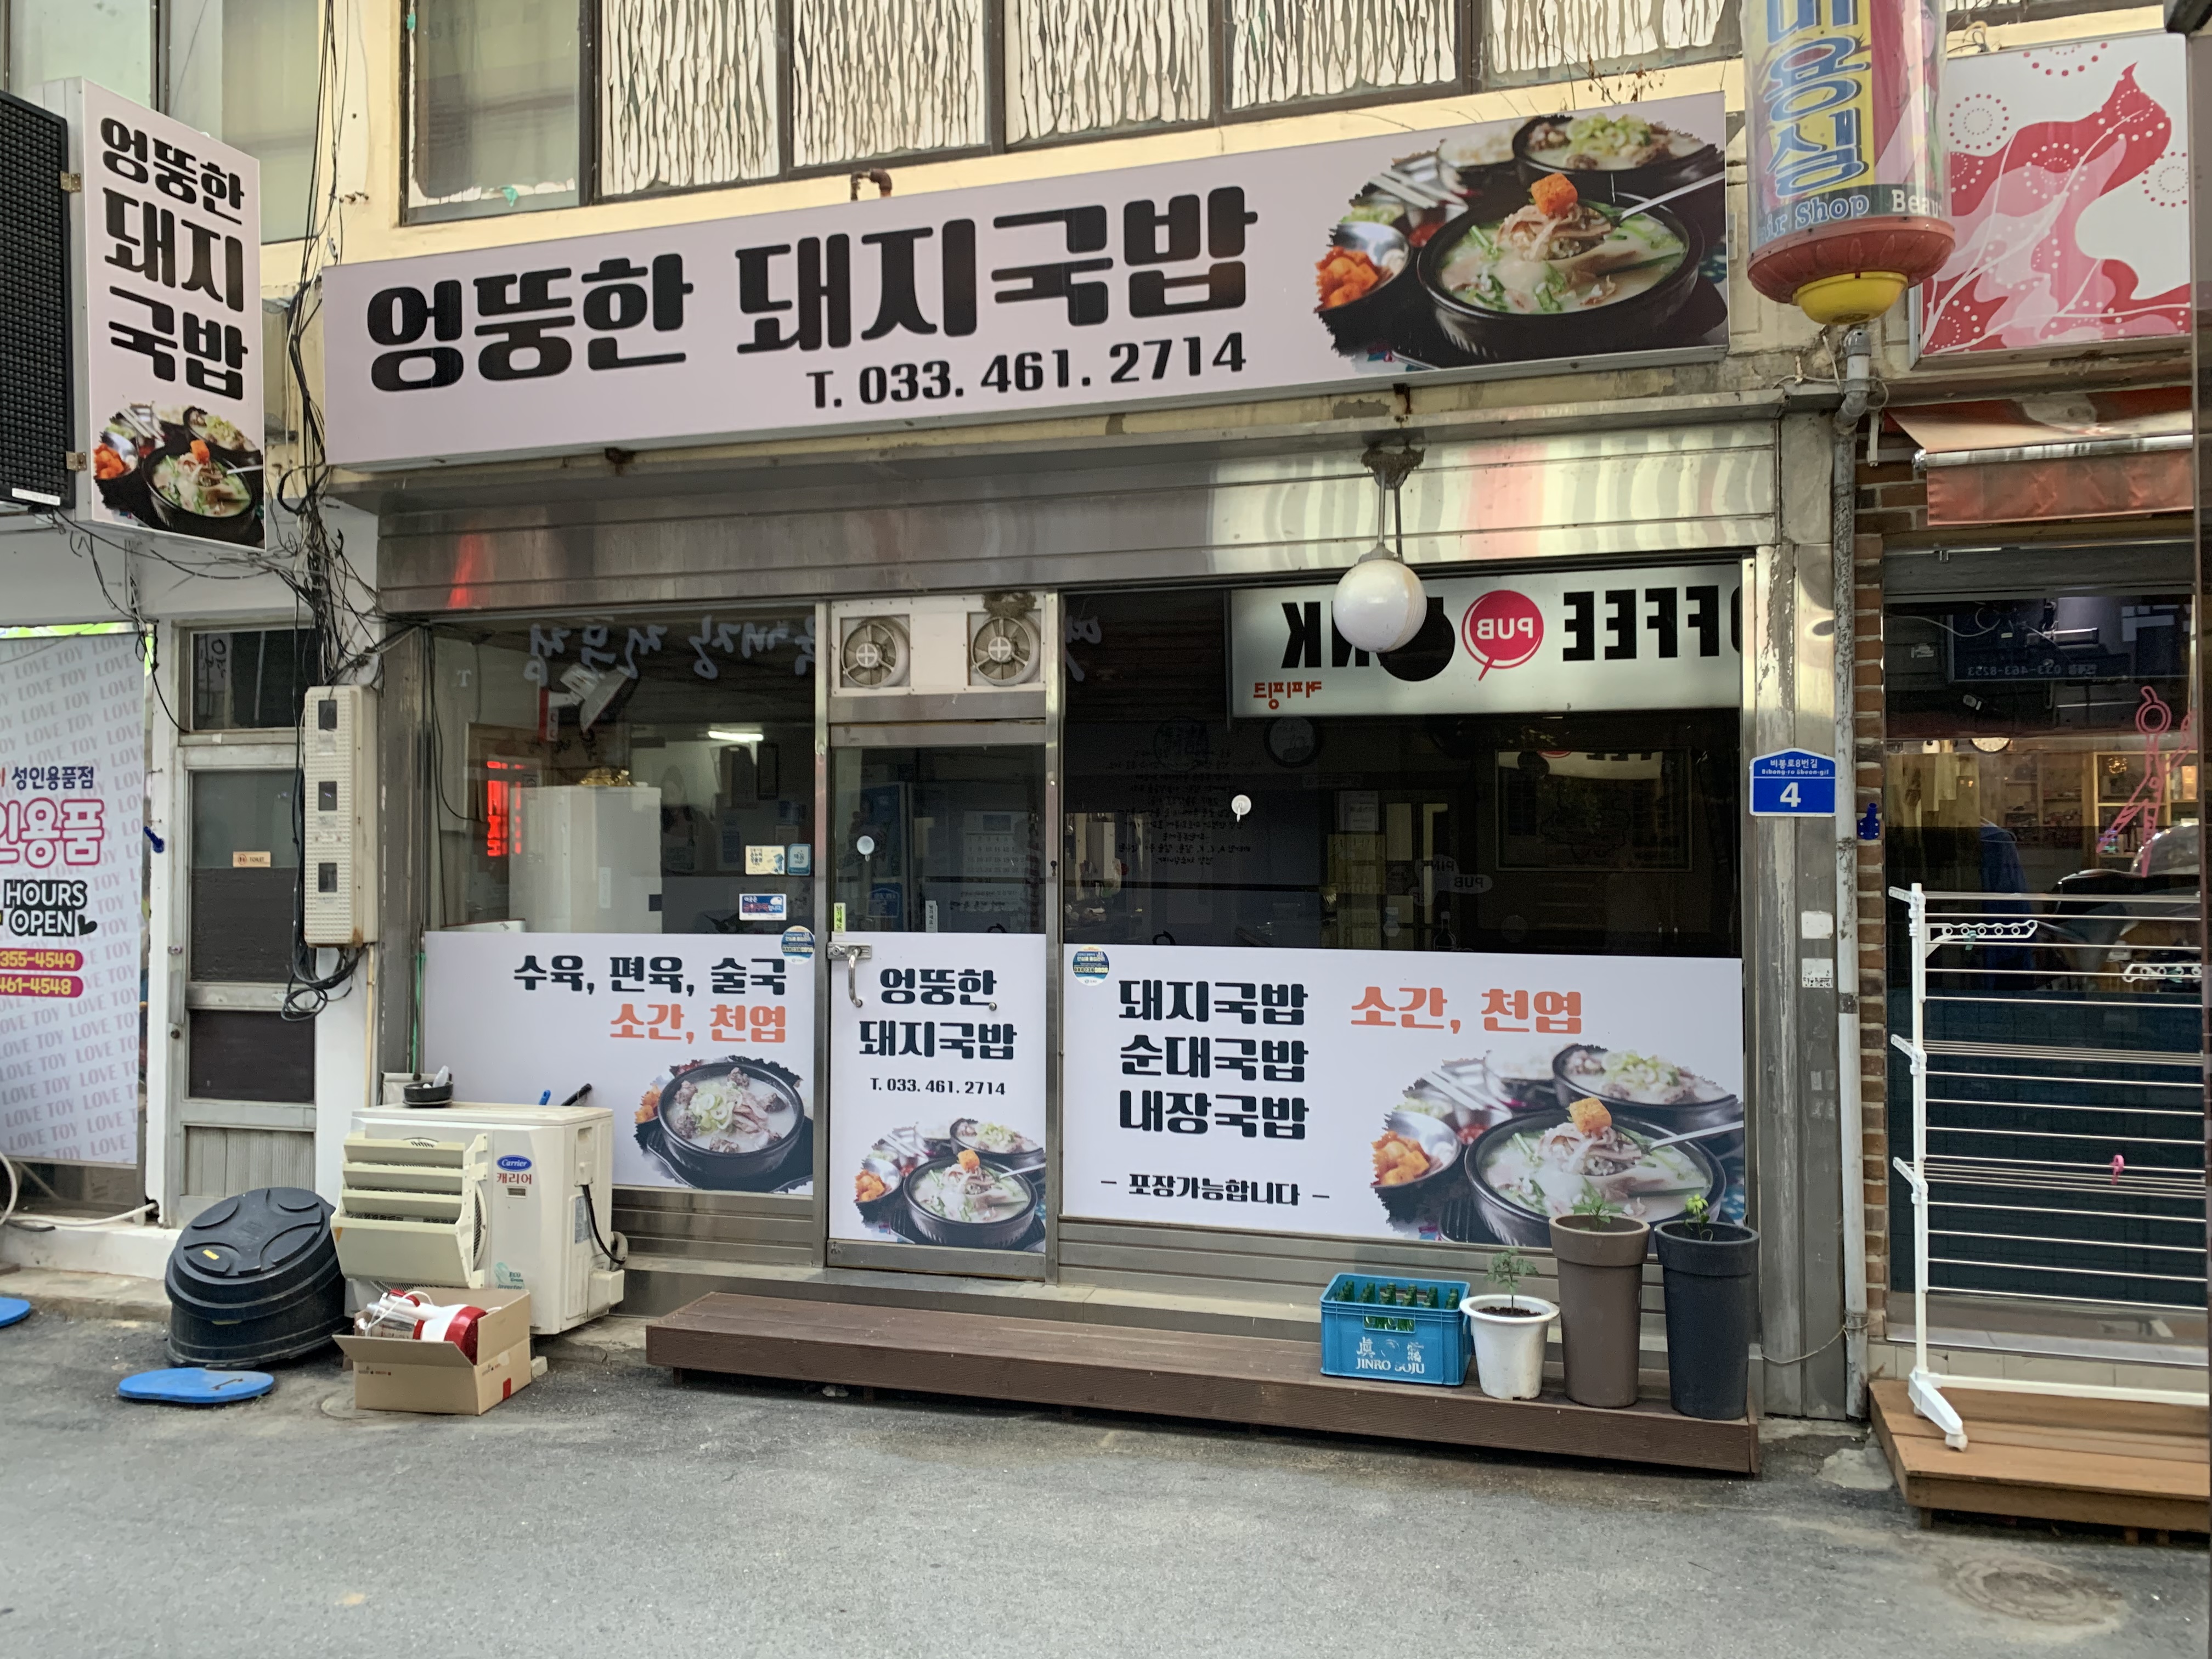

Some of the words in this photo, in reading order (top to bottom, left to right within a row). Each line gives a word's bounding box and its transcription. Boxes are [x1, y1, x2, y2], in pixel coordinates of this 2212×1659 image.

[100, 117, 245, 225] 엉뚱한
[1795, 194, 1870, 229] Shop
[103, 187, 244, 313] 돼지
[367, 252, 694, 392] 엉뚱한
[735, 185, 1258, 353] 돼지국밥
[108, 285, 249, 400] 국밥
[806, 370, 843, 408] T.
[859, 360, 964, 405] 033.
[981, 349, 1091, 393] 461.
[1109, 332, 1246, 384] 2714
[12, 766, 94, 791] 성인용품점
[1770, 759, 1818, 769] 비봉로8번길
[1780, 782, 1802, 808] 4
[5, 882, 86, 907] HOURS
[11, 909, 74, 934] OPEN
[514, 955, 595, 995] 수육,
[609, 956, 695, 997] 편육,
[710, 957, 787, 996] 술국
[879, 968, 997, 1006] 엉뚱한
[610, 1003, 695, 1044] 소간,
[709, 1004, 786, 1043] 천엽
[1119, 979, 1308, 1025] 돼지국밥
[1351, 986, 1461, 1035] 소간,
[1481, 988, 1582, 1035] 천엽
[859, 1020, 1017, 1060] 돼지국밥
[1120, 1035, 1309, 1082] 순대국밥
[870, 1077, 882, 1091] T.
[887, 1078, 921, 1092] 033.
[926, 1079, 960, 1094] 461.
[964, 1081, 1006, 1096] 2714
[1120, 1090, 1310, 1140] 내장국밥
[496, 1172, 532, 1185] 캐리어
[501, 1159, 527, 1167] Carrier
[1128, 1173, 1300, 1206] 포장가능합니다
[1355, 1357, 1392, 1371] JINRO
